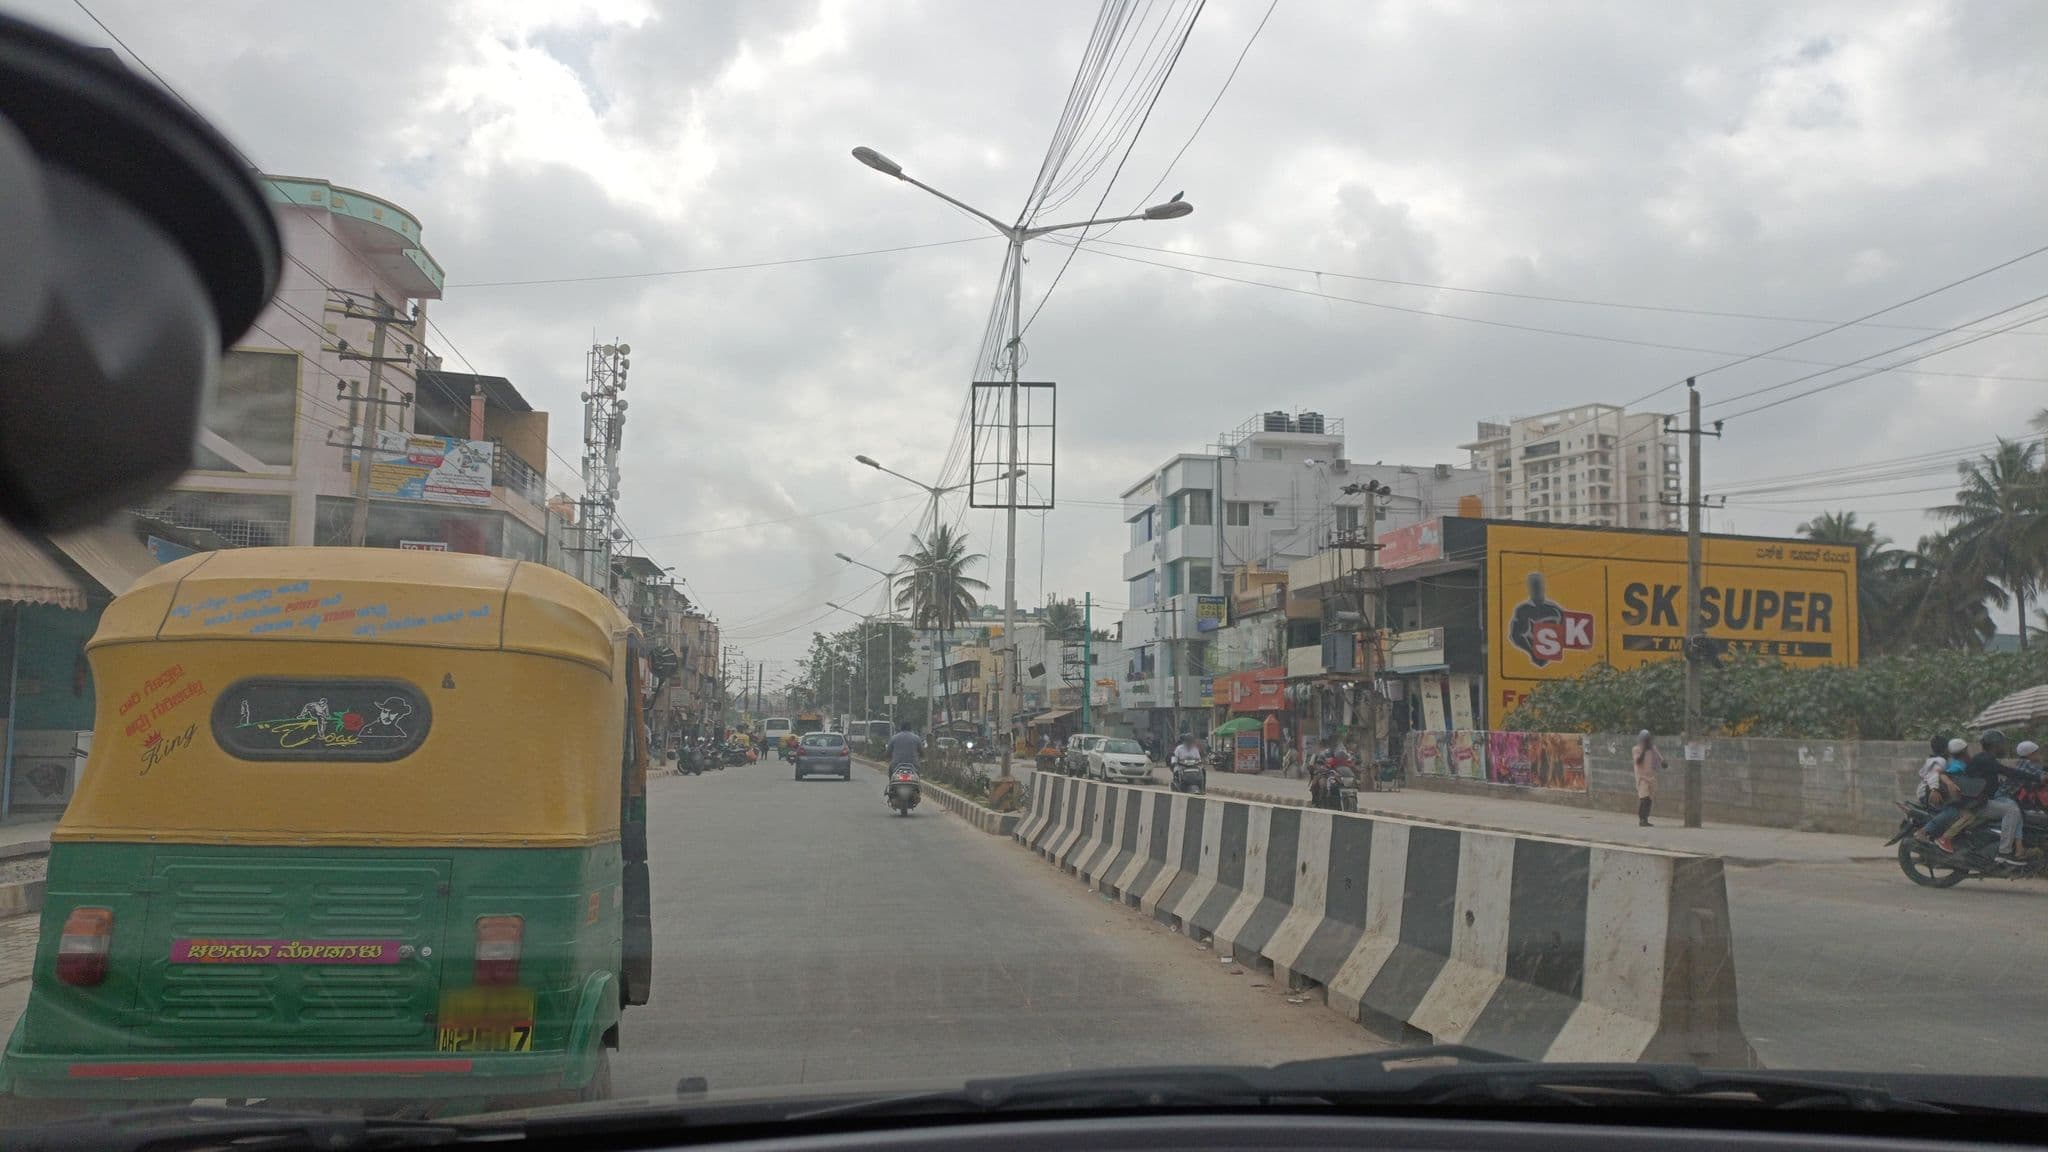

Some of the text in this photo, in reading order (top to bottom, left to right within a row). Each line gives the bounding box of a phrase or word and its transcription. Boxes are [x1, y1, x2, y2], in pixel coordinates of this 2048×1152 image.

[1621, 583, 1832, 632] SK SUPER
[1535, 617, 1590, 656] SK
[1652, 637, 1804, 656] TM STEEL
[139, 722, 198, 777] King
[187, 941, 384, 959] ಚಲಿಸುವ ಮೋಡಗಳು
